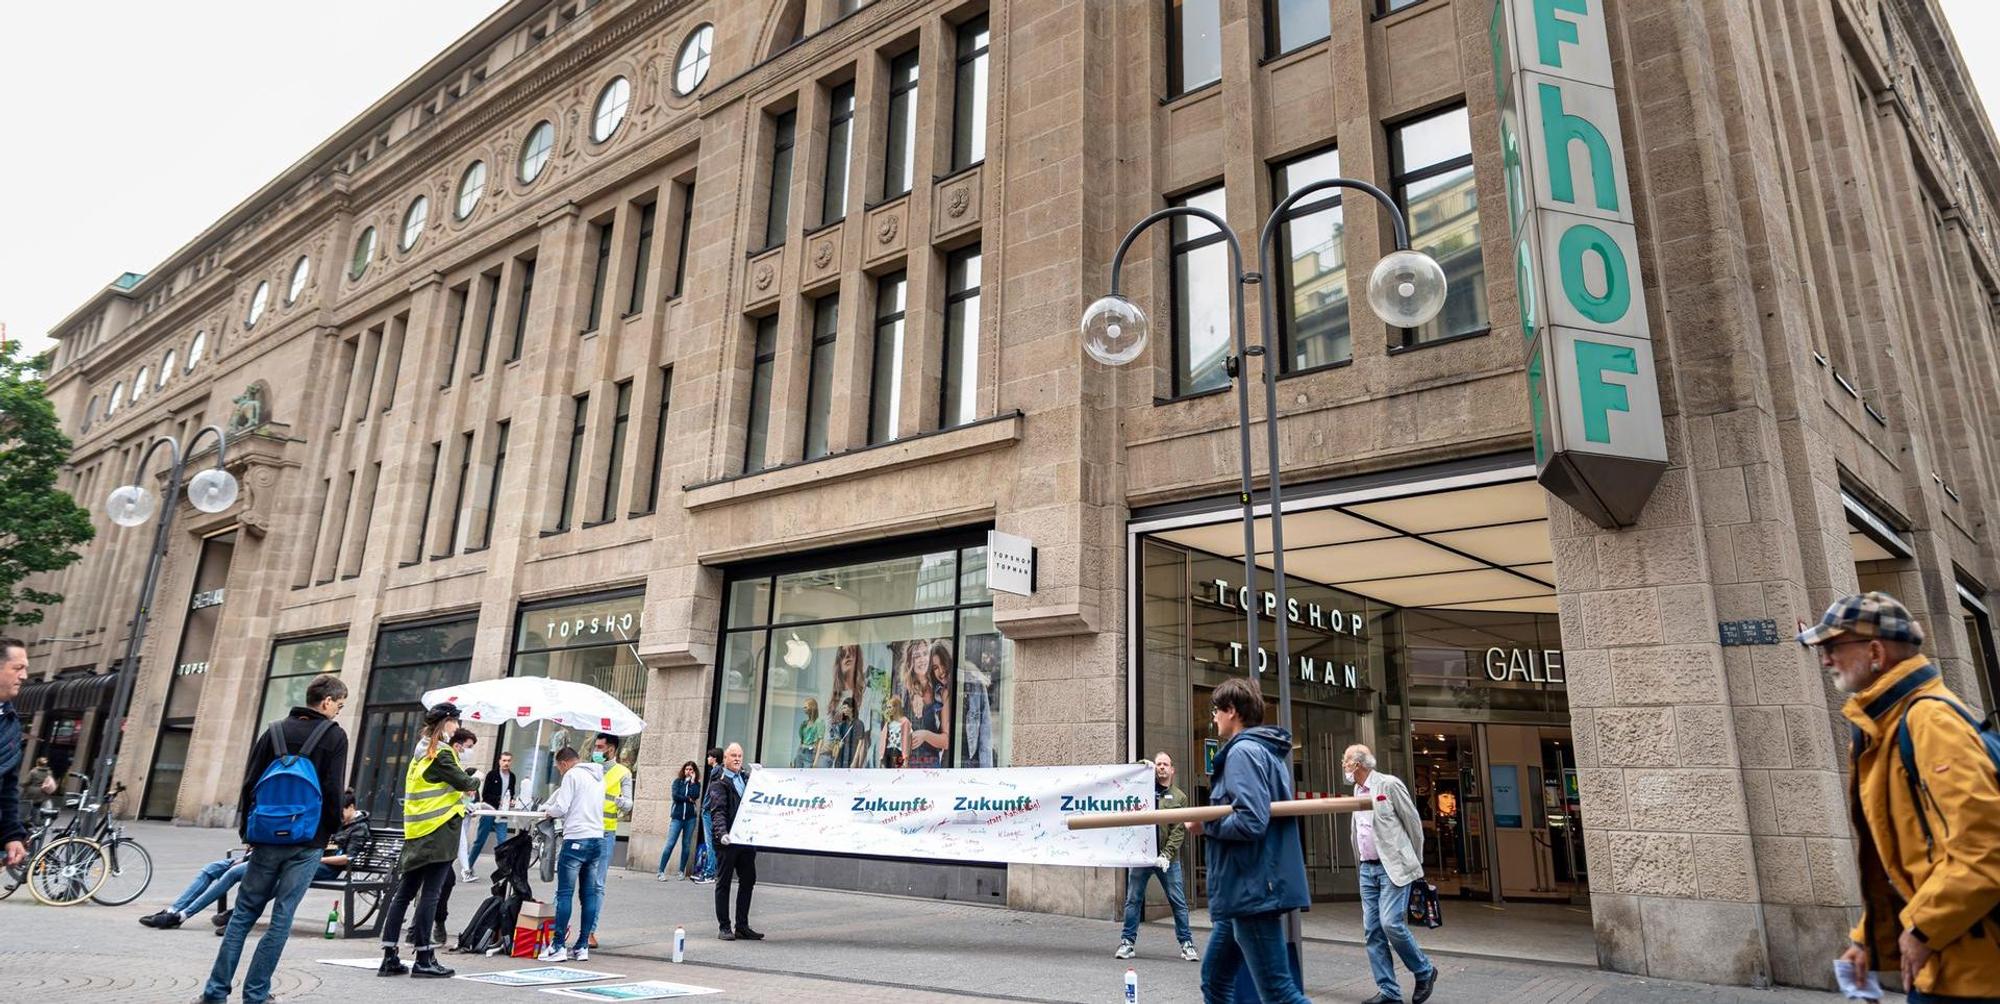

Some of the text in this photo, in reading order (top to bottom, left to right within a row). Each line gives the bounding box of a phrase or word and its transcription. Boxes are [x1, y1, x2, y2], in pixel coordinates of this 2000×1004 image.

[993, 551, 1031, 564] TOPSHOP
[996, 563, 1028, 574] TOPMAN
[547, 612, 644, 639] TOPSHO
[1230, 642, 1356, 689] TOMAN
[1486, 647, 1564, 683] GALE
[749, 791, 826, 809] Zukunft
[851, 797, 927, 812] Zukunft
[953, 795, 1032, 812] Zukunft
[1060, 795, 1141, 812] Zukunft
